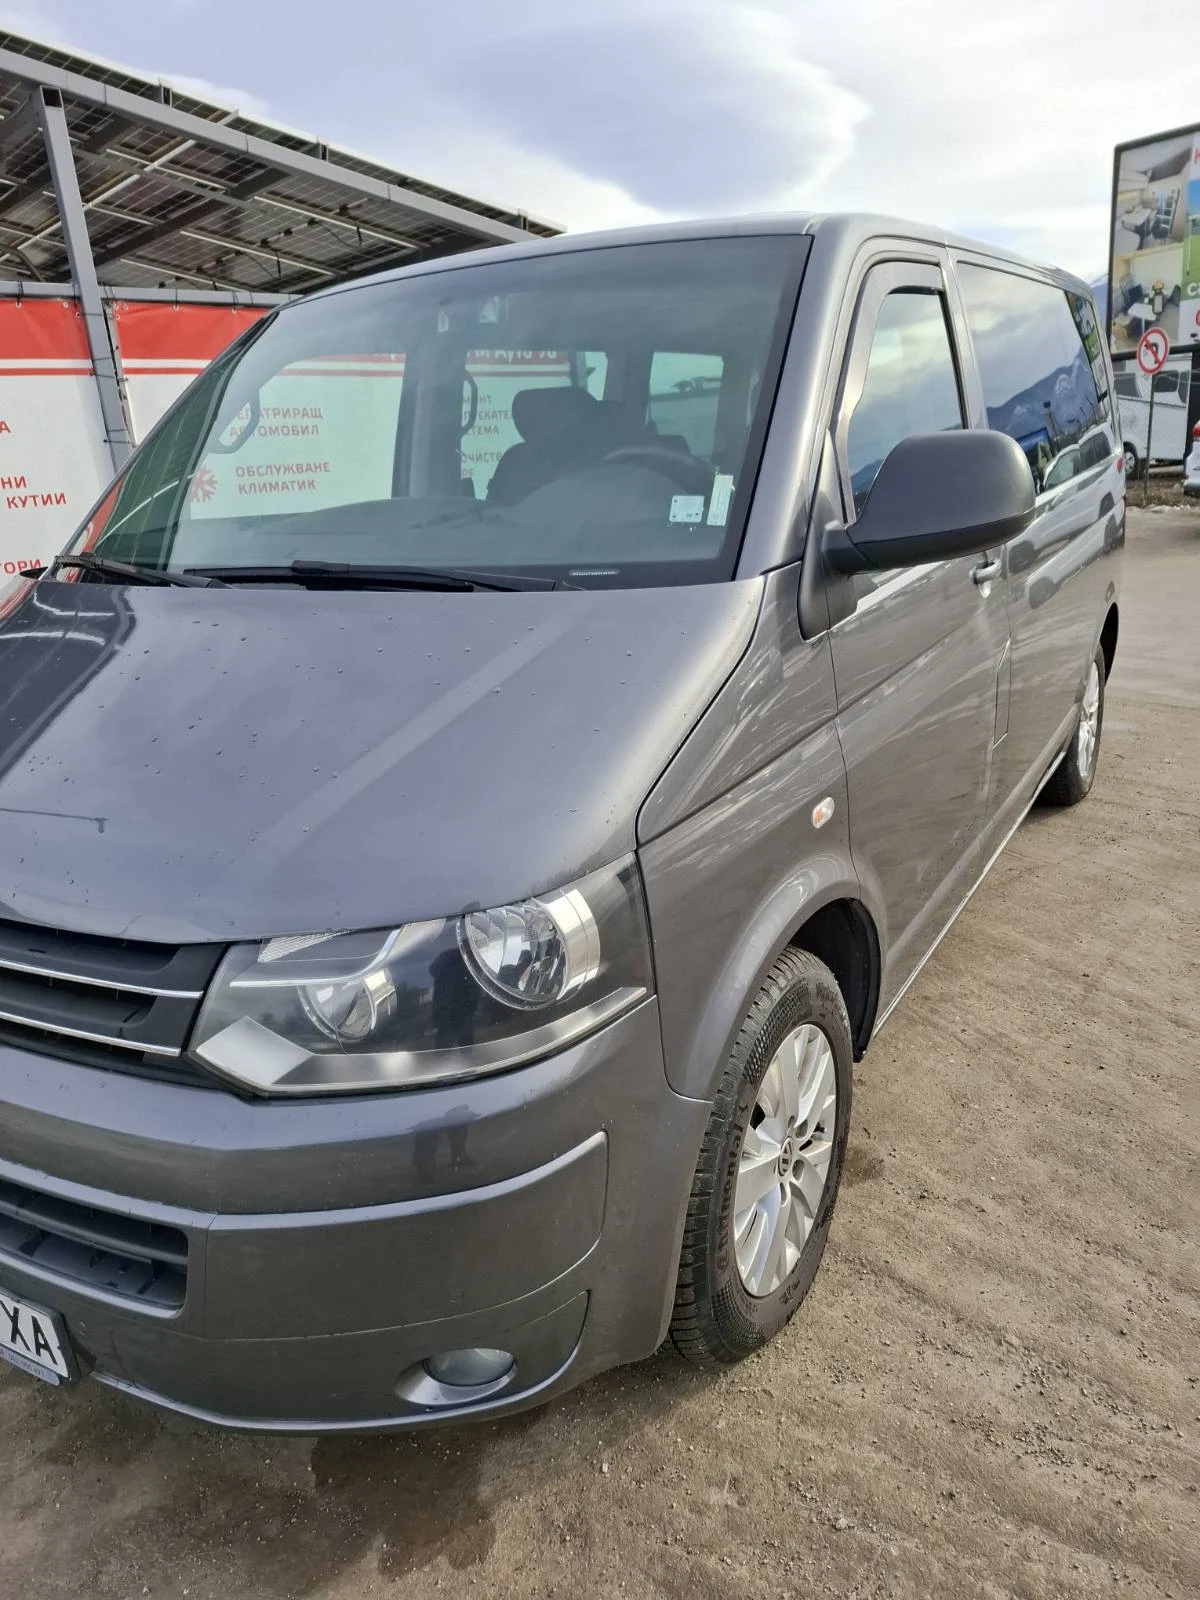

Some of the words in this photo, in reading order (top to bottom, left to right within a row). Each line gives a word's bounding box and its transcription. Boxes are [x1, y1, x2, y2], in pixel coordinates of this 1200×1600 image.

[235, 462, 330, 478] ОБСЛУЖВАНЕ
[238, 479, 317, 495] КЛИМАТИК
[7, 493, 66, 509] КУТИИ
[0, 559, 41, 575] ОРИ
